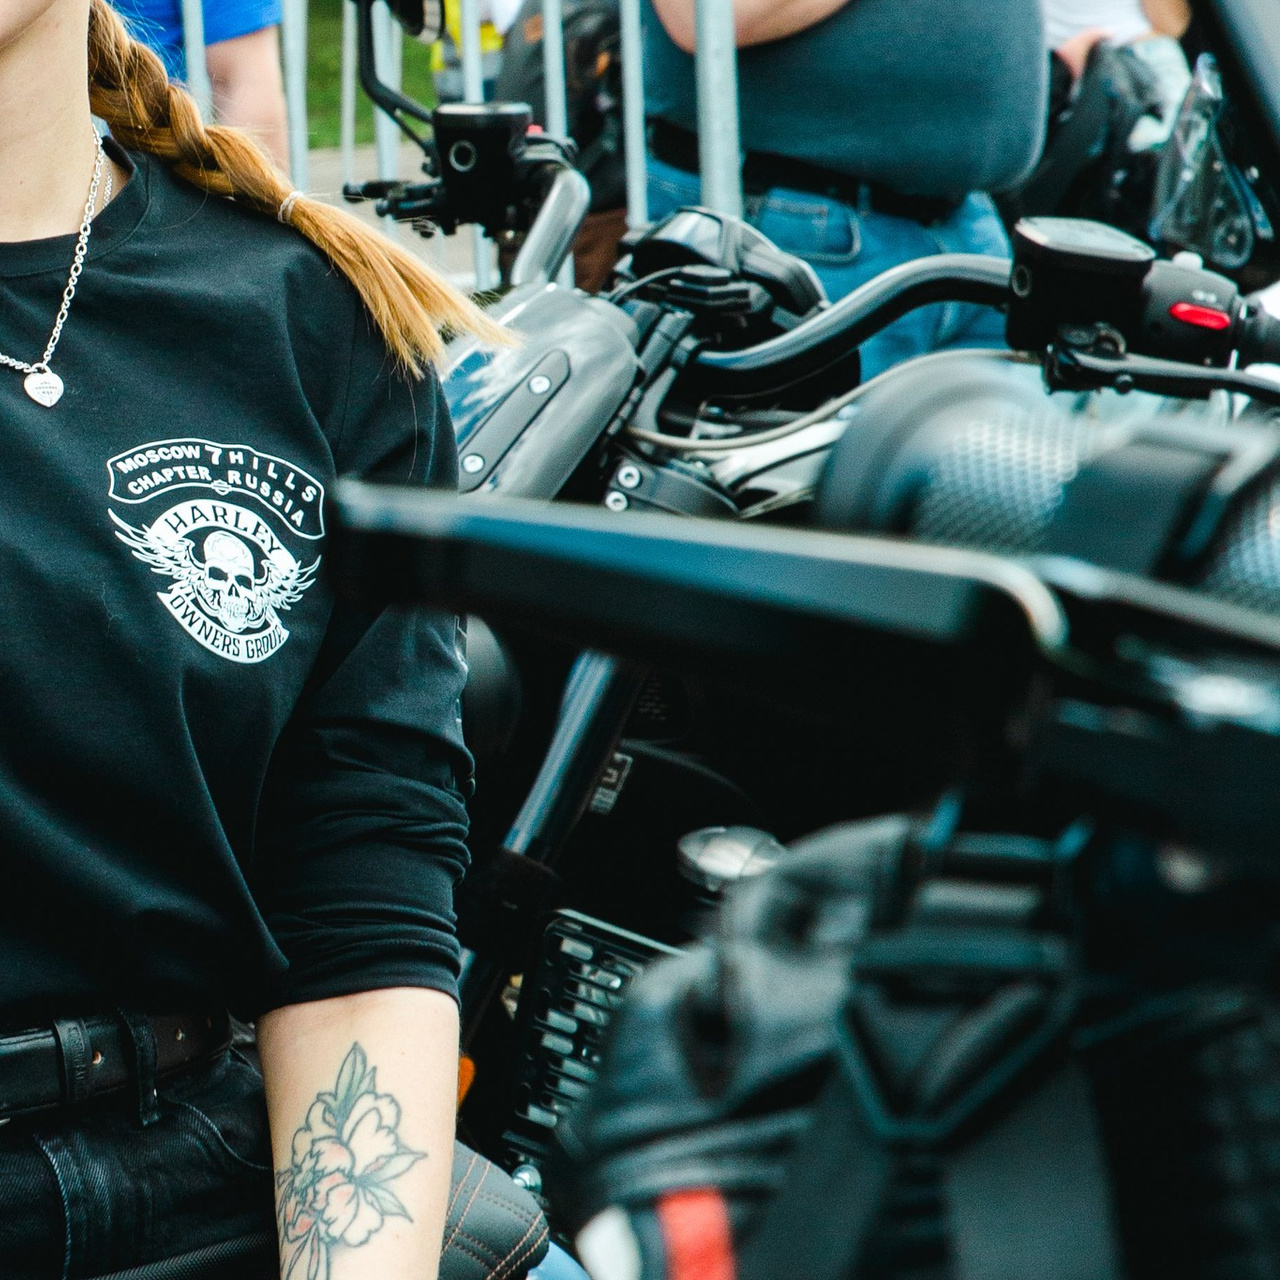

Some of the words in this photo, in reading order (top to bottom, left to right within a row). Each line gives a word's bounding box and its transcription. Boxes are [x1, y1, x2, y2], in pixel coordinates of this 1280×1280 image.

[116, 445, 200, 474] MOSCOW
[205, 445, 222, 465] 7
[229, 450, 317, 503] HILLS
[127, 465, 212, 495] CHAPTER
[227, 470, 305, 528] RUSSIA
[164, 504, 282, 554] HARLEY
[170, 593, 241, 657] OWNERS
[245, 627, 284, 659] GROUP
